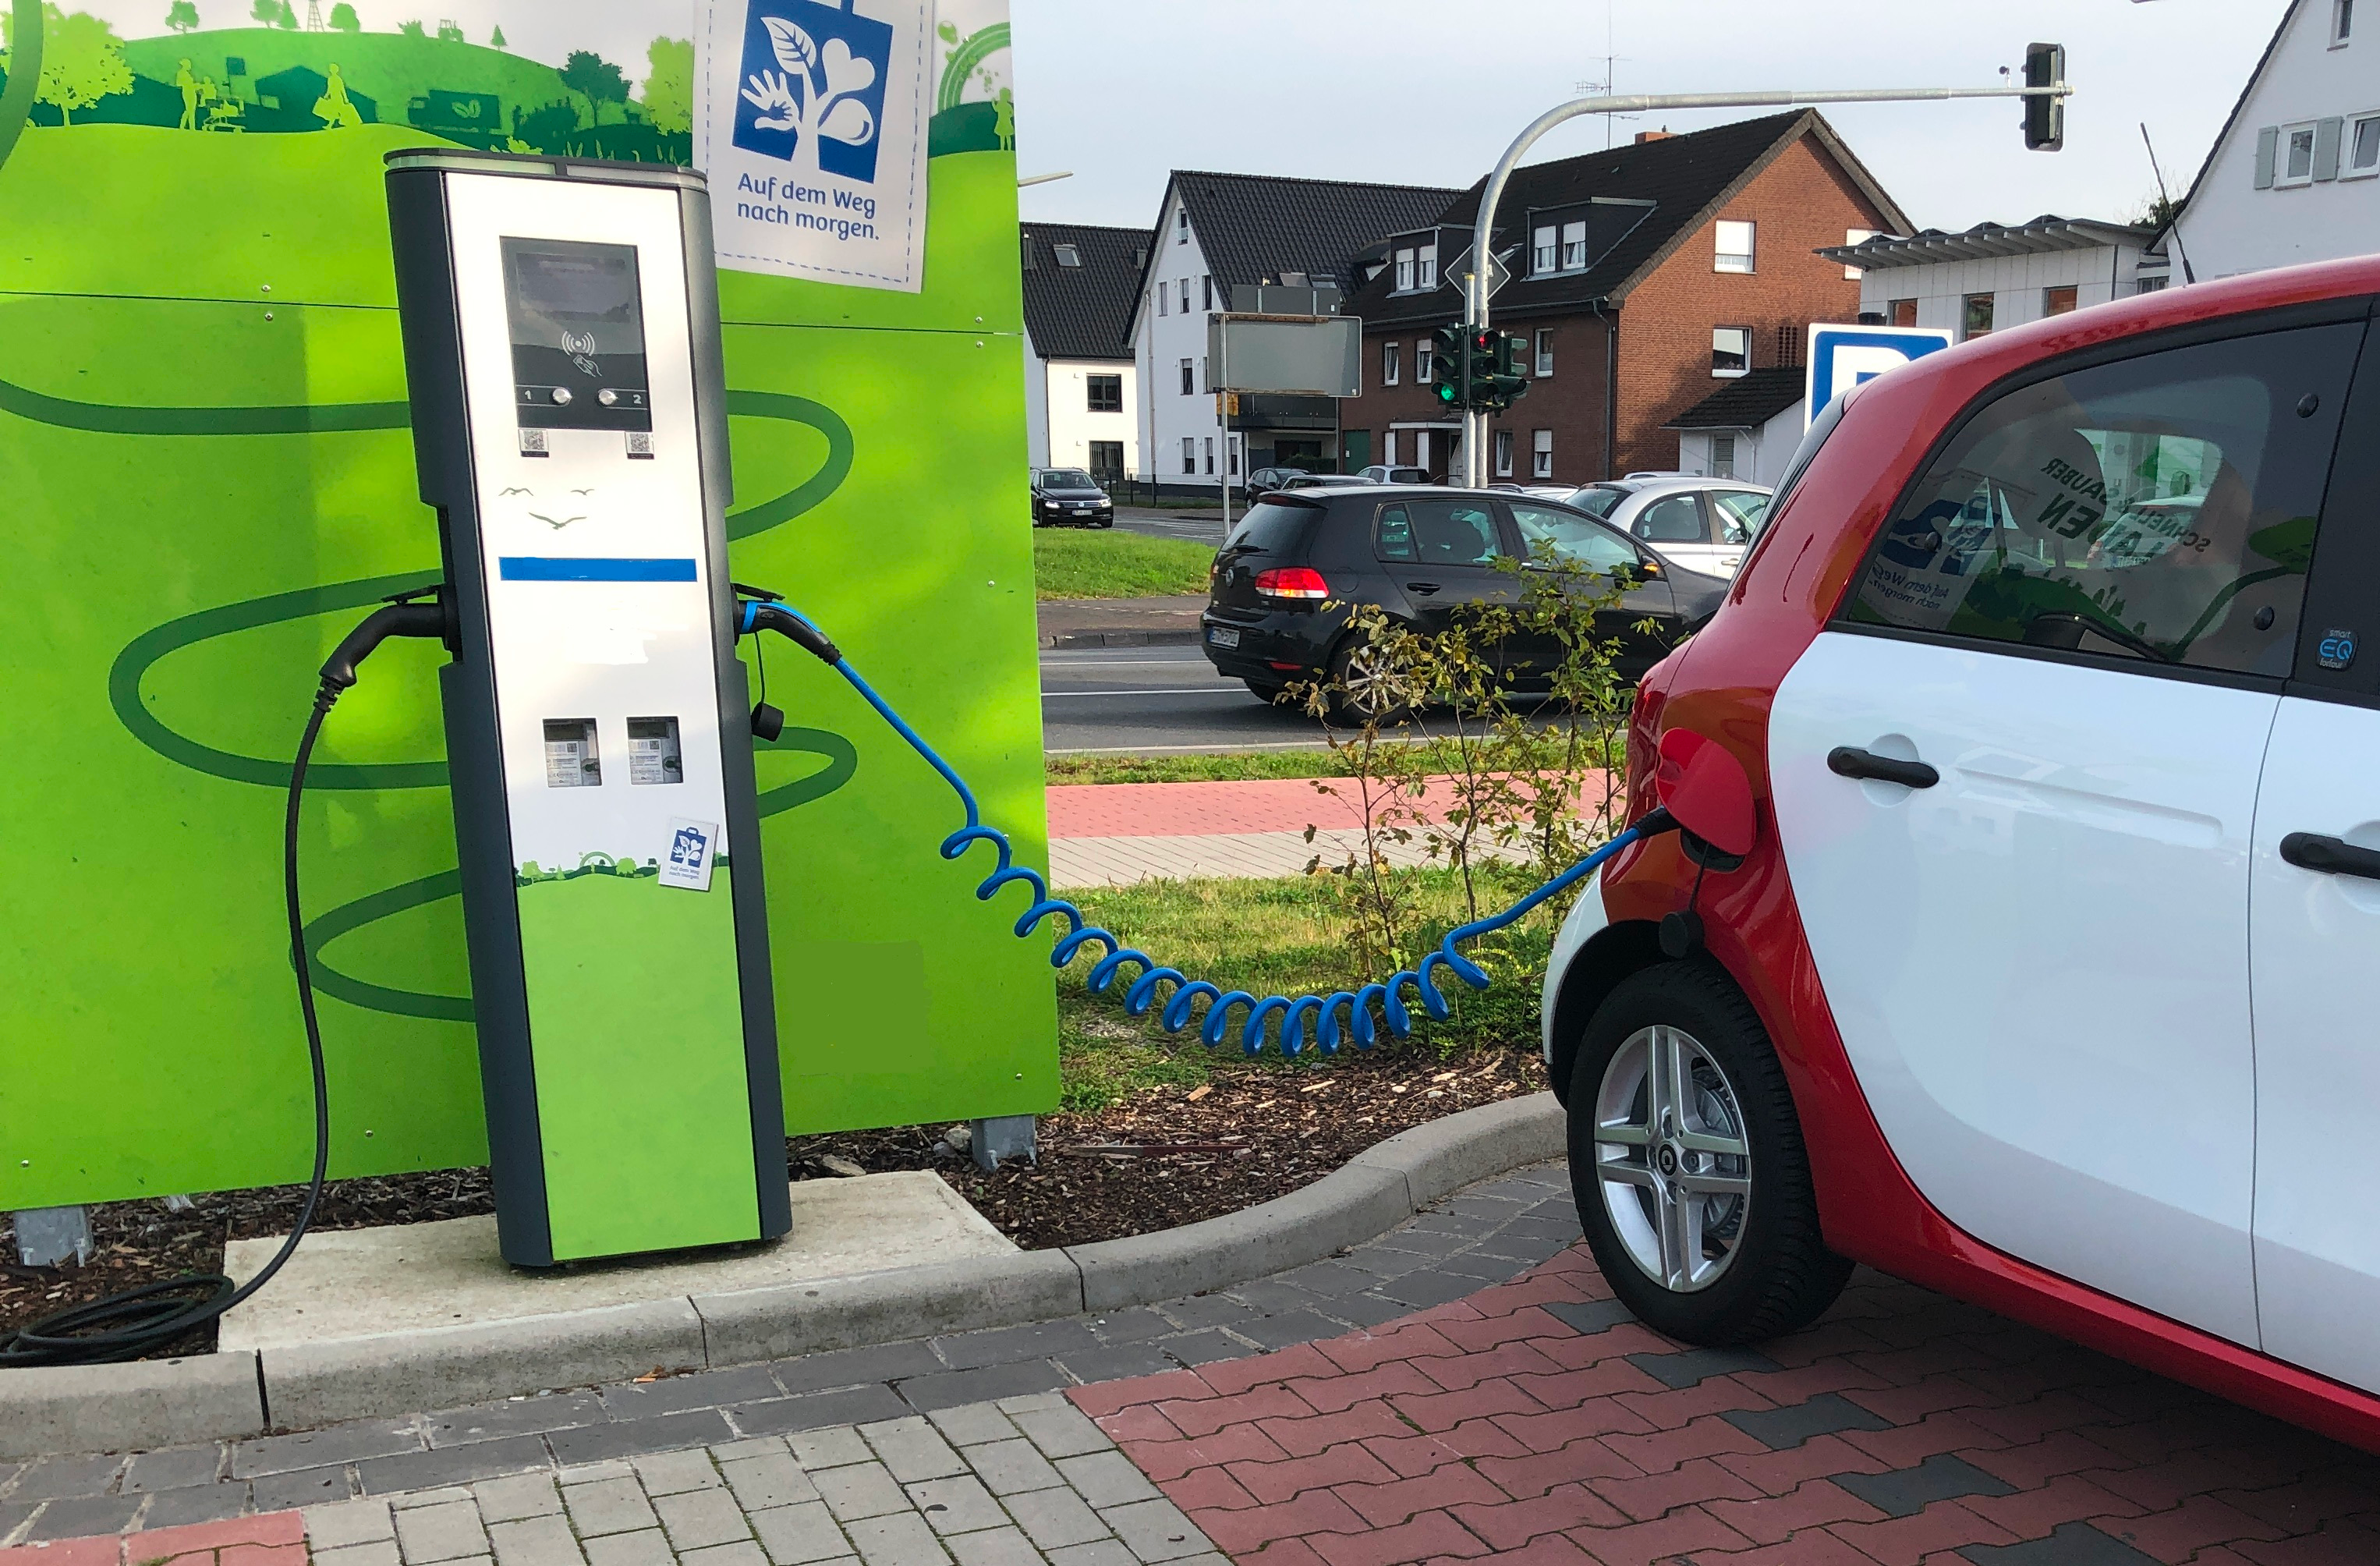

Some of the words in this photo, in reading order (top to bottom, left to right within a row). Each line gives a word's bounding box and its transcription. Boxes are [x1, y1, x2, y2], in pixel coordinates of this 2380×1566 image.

[737, 172, 777, 201] Auf
[781, 180, 826, 205] dem
[832, 188, 876, 219] Weg
[737, 202, 788, 225] nach
[795, 212, 880, 241] morgen.
[524, 390, 532, 400] 1
[632, 394, 642, 405] 2
[2329, 629, 2350, 638] smart
[2319, 638, 2353, 661] EQ
